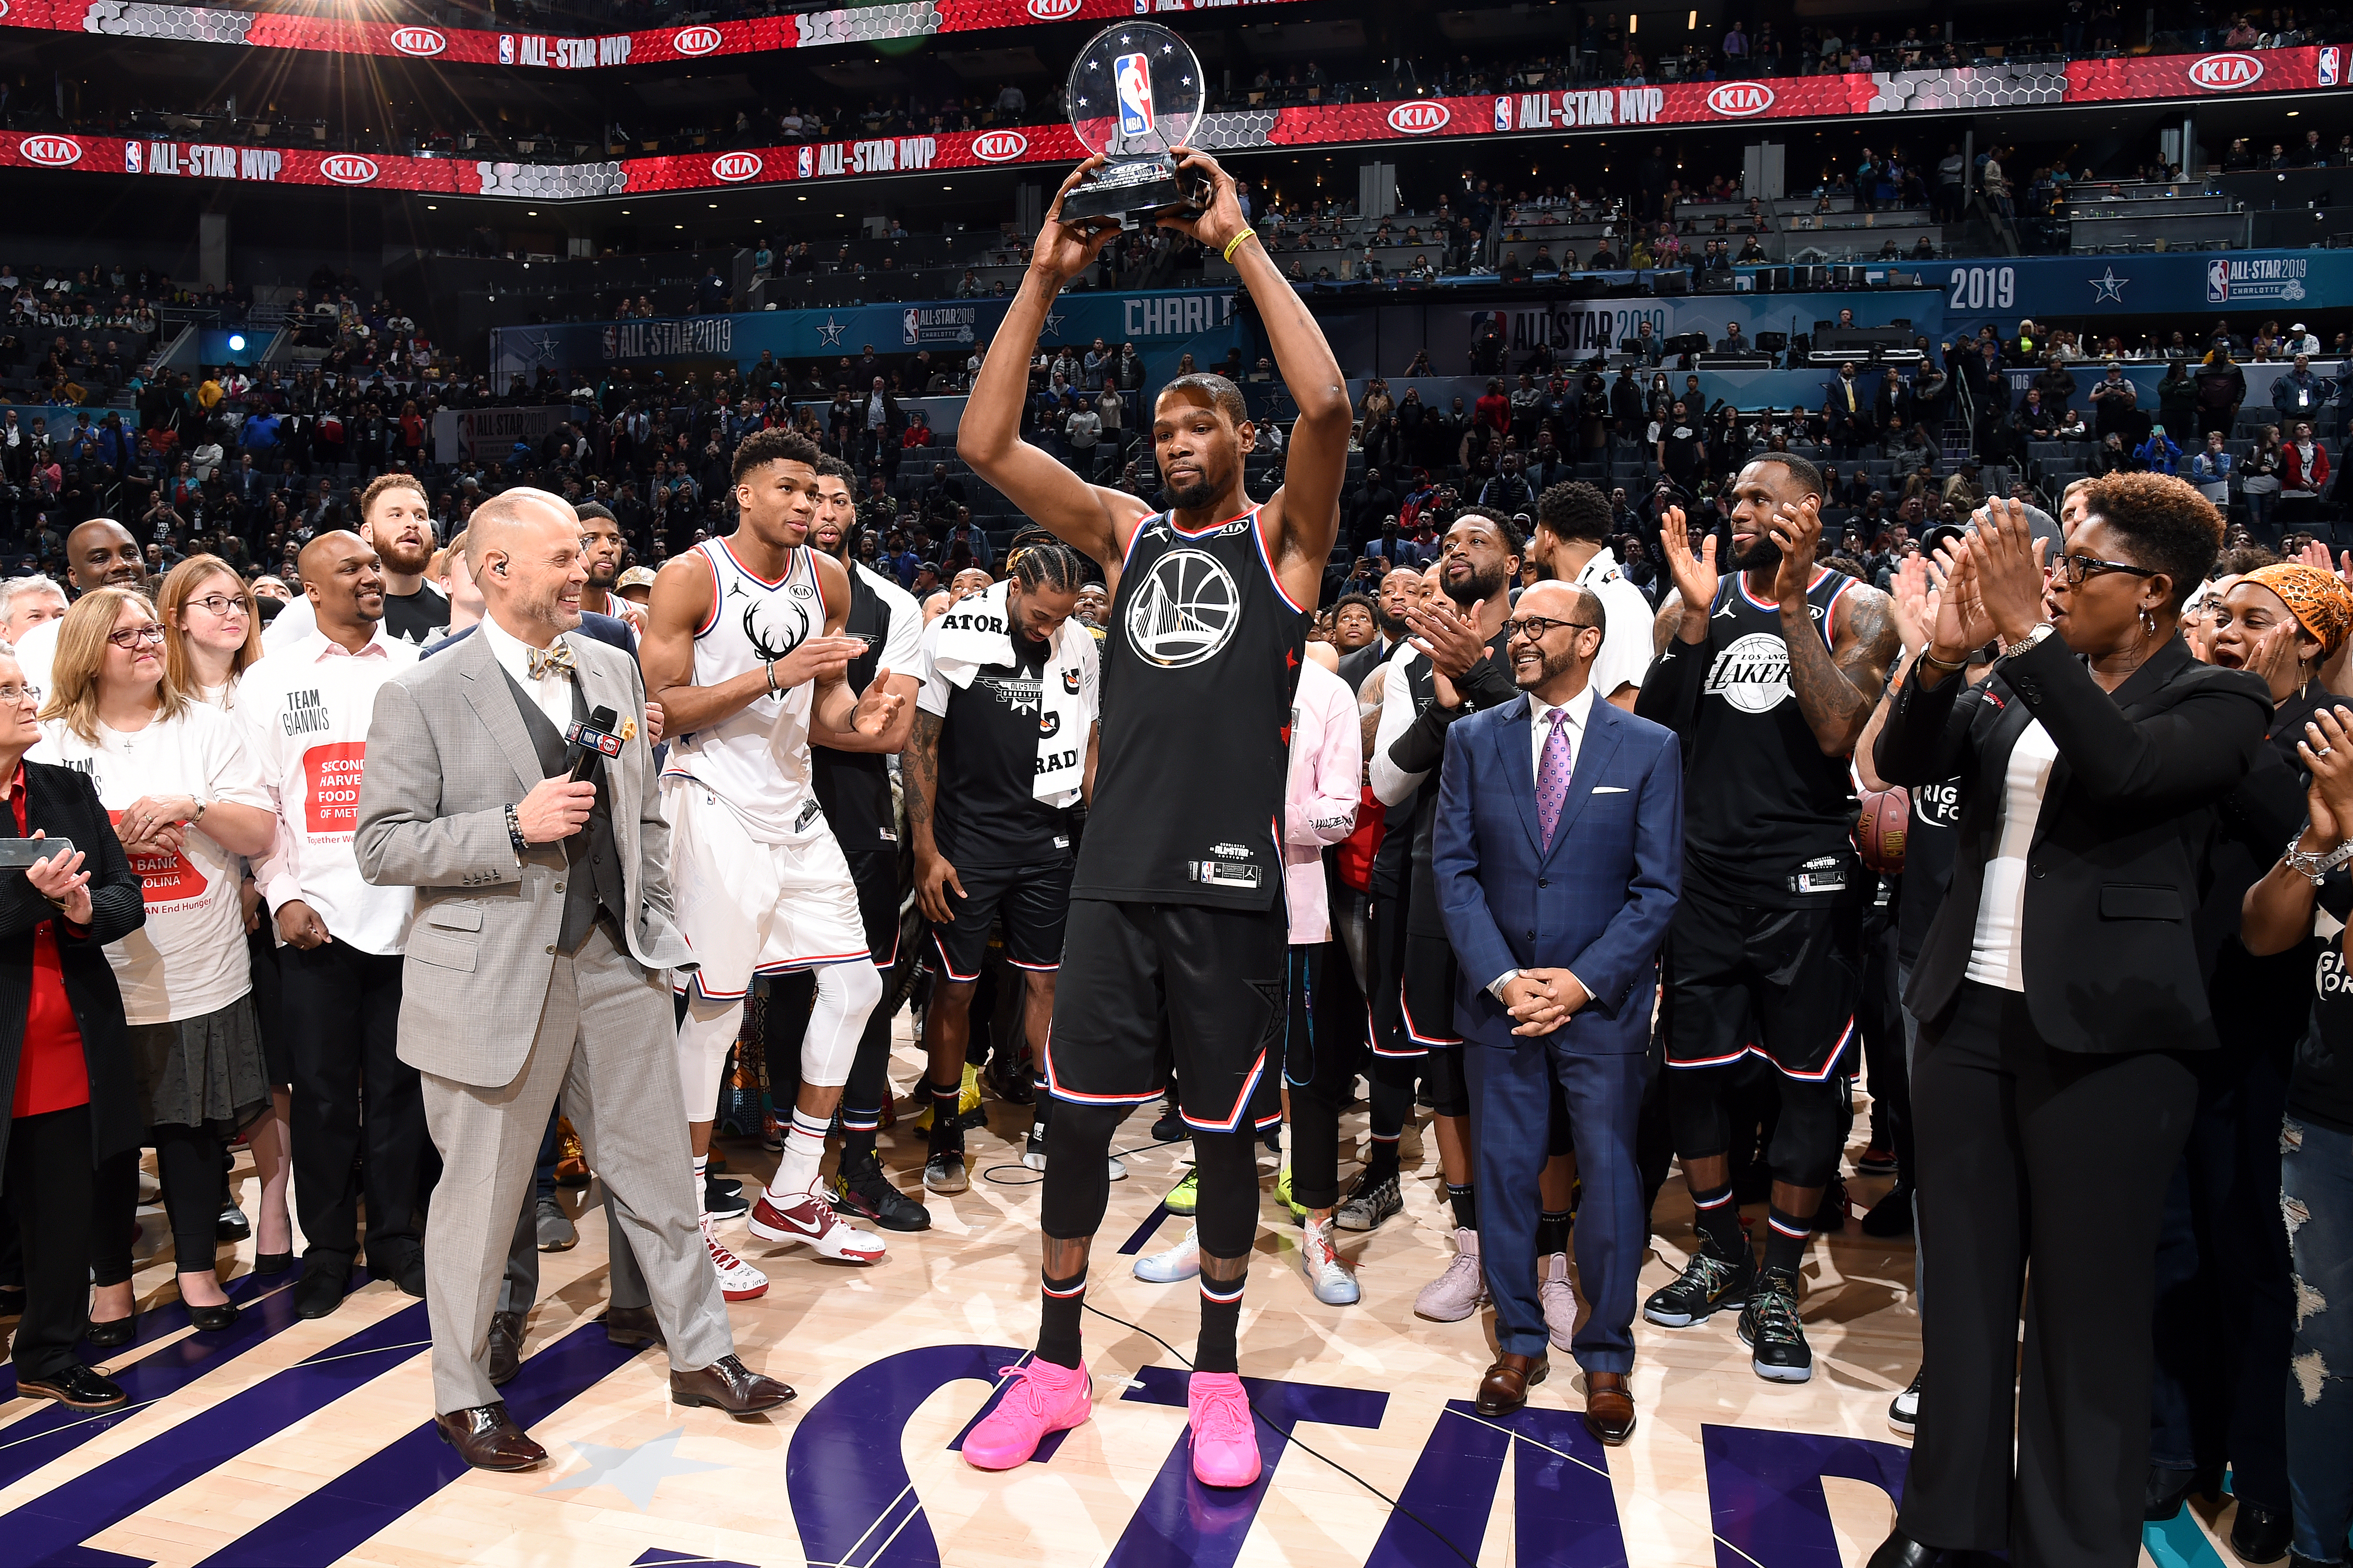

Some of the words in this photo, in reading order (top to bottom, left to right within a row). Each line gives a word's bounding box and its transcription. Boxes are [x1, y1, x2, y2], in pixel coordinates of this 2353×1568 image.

[402, 32, 438, 50] KIA
[682, 32, 714, 49] KIA
[520, 36, 596, 68] ALL-STAR
[600, 35, 631, 66] MVP
[2202, 61, 2250, 82] KIA
[1720, 89, 1762, 108] KIA
[1399, 108, 1439, 126] KIA
[1519, 90, 1613, 129] ALL-STAR
[1619, 89, 1663, 124] MVP
[1126, 116, 1143, 131] NBA
[31, 141, 71, 159] KIA
[982, 137, 1018, 154] KIA
[149, 143, 236, 178] ALL-STAR
[241, 149, 281, 180] MVP
[720, 157, 754, 174] KIA
[818, 140, 895, 176] ALL-STAR
[900, 138, 936, 169] MVP
[330, 160, 369, 177] KIA
[2282, 259, 2306, 278] 2019
[1950, 266, 2015, 308] 2019
[2233, 286, 2280, 294] CHARLOTTE
[957, 308, 974, 324] 2019
[695, 319, 731, 353] 2019
[2011, 374, 2029, 390] 106
[287, 689, 320, 710] TEAM
[283, 708, 329, 736] GIANNIS
[583, 732, 596, 744] NBA
[1034, 748, 1078, 775] RAD
[318, 790, 356, 802] FOOD
[320, 809, 332, 819] OF
[307, 836, 340, 845] Together
[137, 857, 178, 871] BANK
[141, 876, 180, 888] OLINA
[162, 904, 179, 913] End
[182, 898, 211, 910] Hunger
